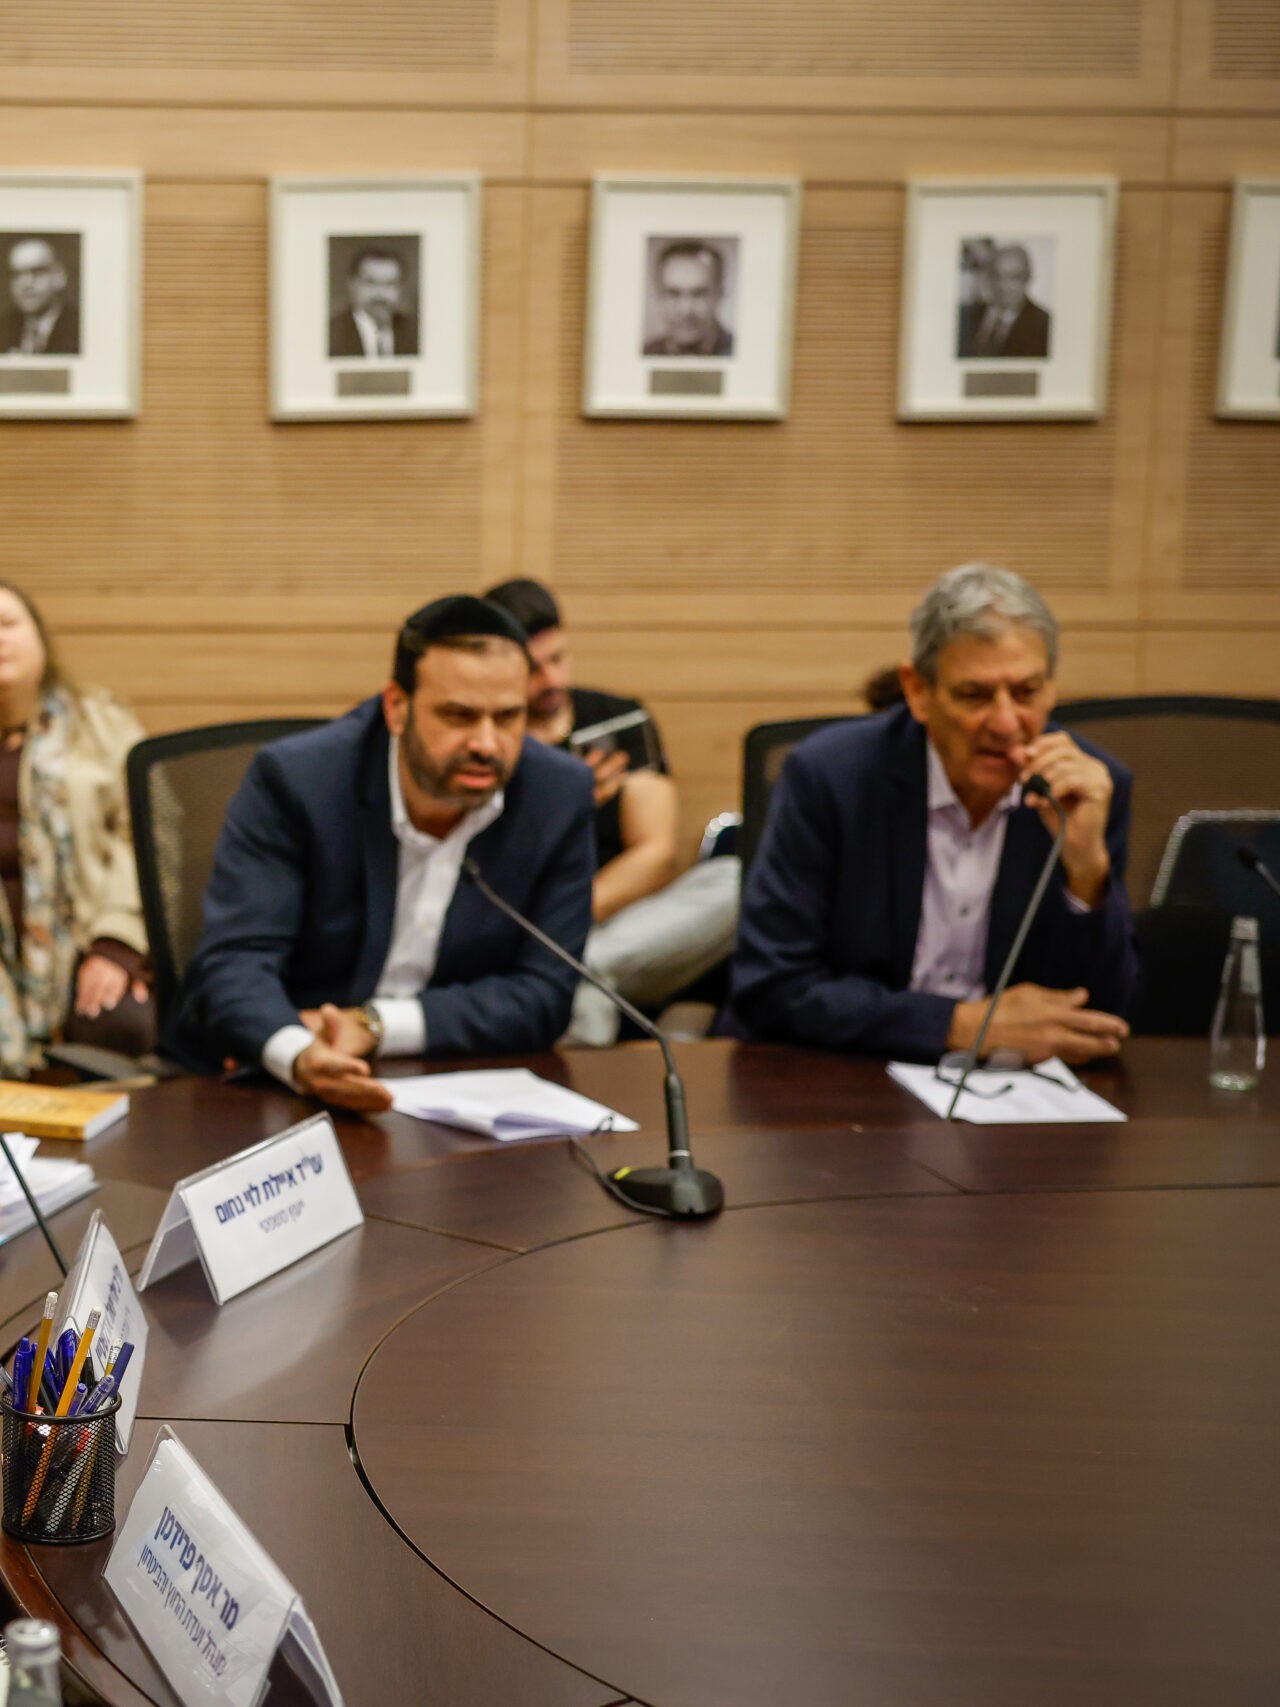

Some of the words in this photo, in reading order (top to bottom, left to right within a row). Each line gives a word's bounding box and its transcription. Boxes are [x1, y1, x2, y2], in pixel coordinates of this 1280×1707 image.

[215, 1195, 245, 1224] נחום
[243, 1184, 261, 1207] לוי
[154, 1506, 197, 1571] פרידמן
[163, 1580, 187, 1619] החוץ
[191, 1553, 223, 1608] אסף
[180, 1607, 204, 1646] ועדת
[219, 1588, 240, 1631] מר
